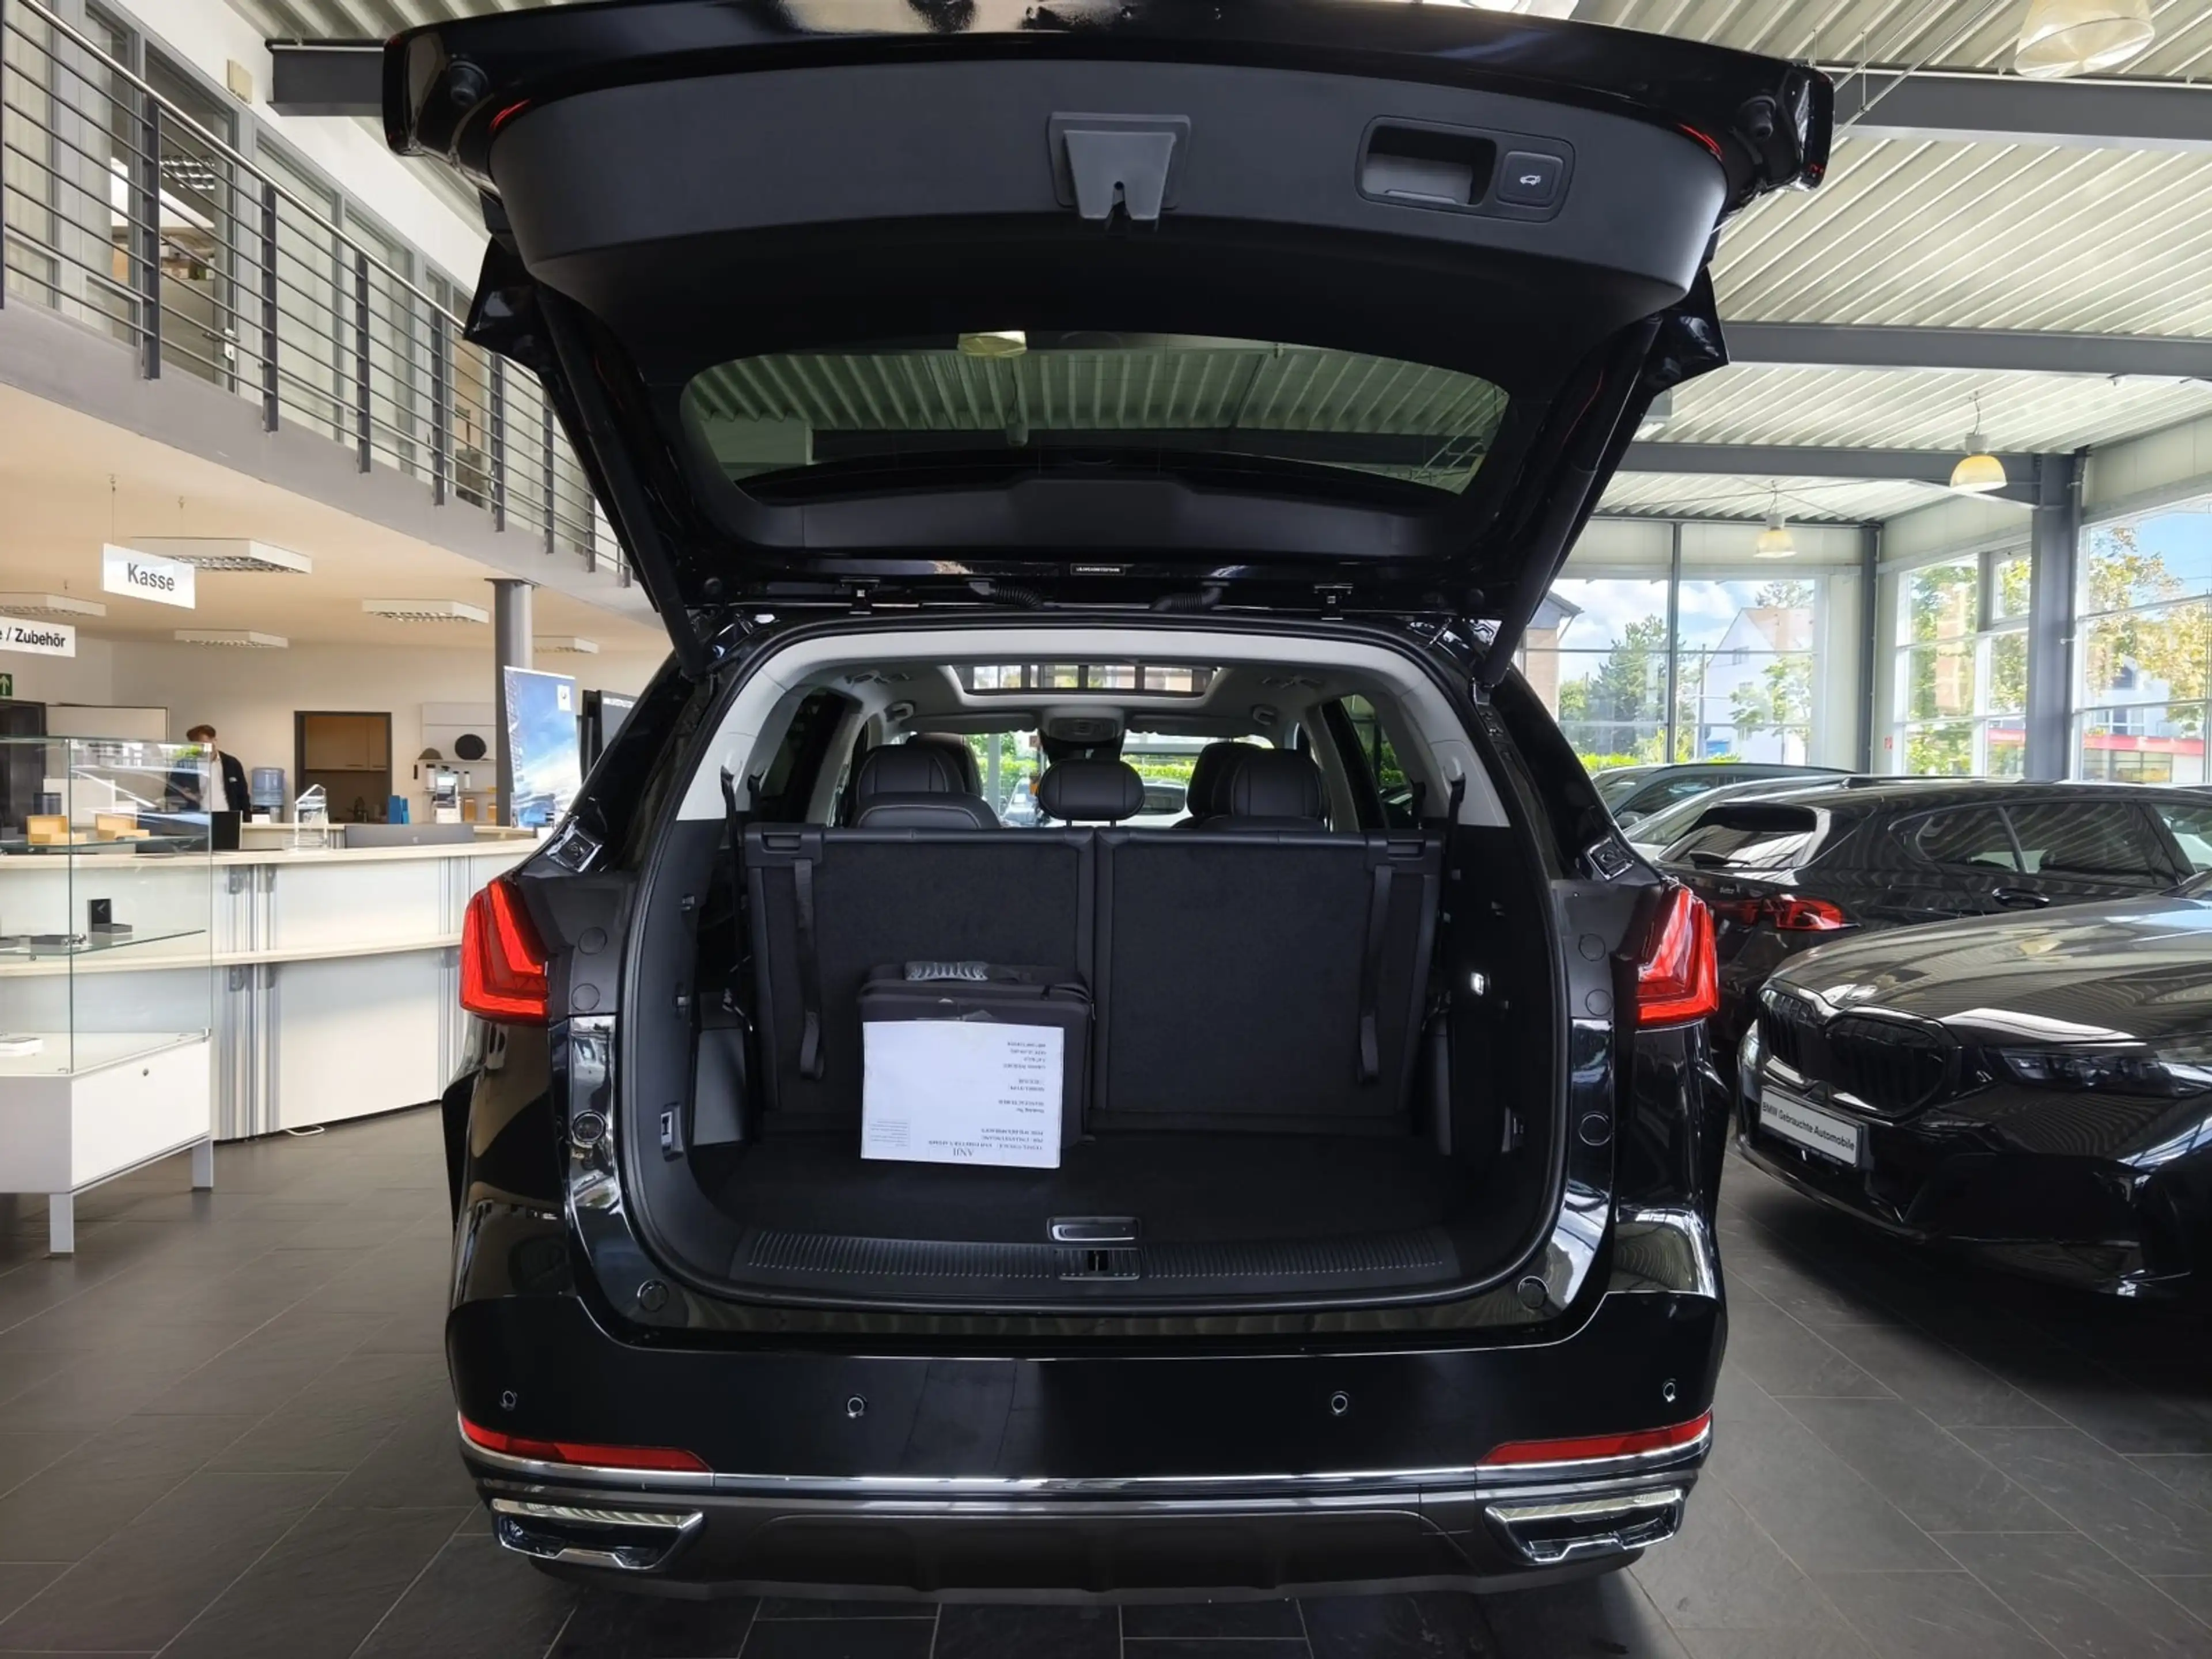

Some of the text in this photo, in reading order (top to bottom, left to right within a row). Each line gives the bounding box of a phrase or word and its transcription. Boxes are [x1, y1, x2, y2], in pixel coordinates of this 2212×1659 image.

[127, 562, 175, 591] Kasse
[15, 627, 66, 647] Zubehör
[1763, 1101, 1777, 1116] BMW
[1778, 1109, 1813, 1134] Gebrauchte
[1814, 1125, 1855, 1152] Automobile
[953, 1147, 975, 1156] ANJI
